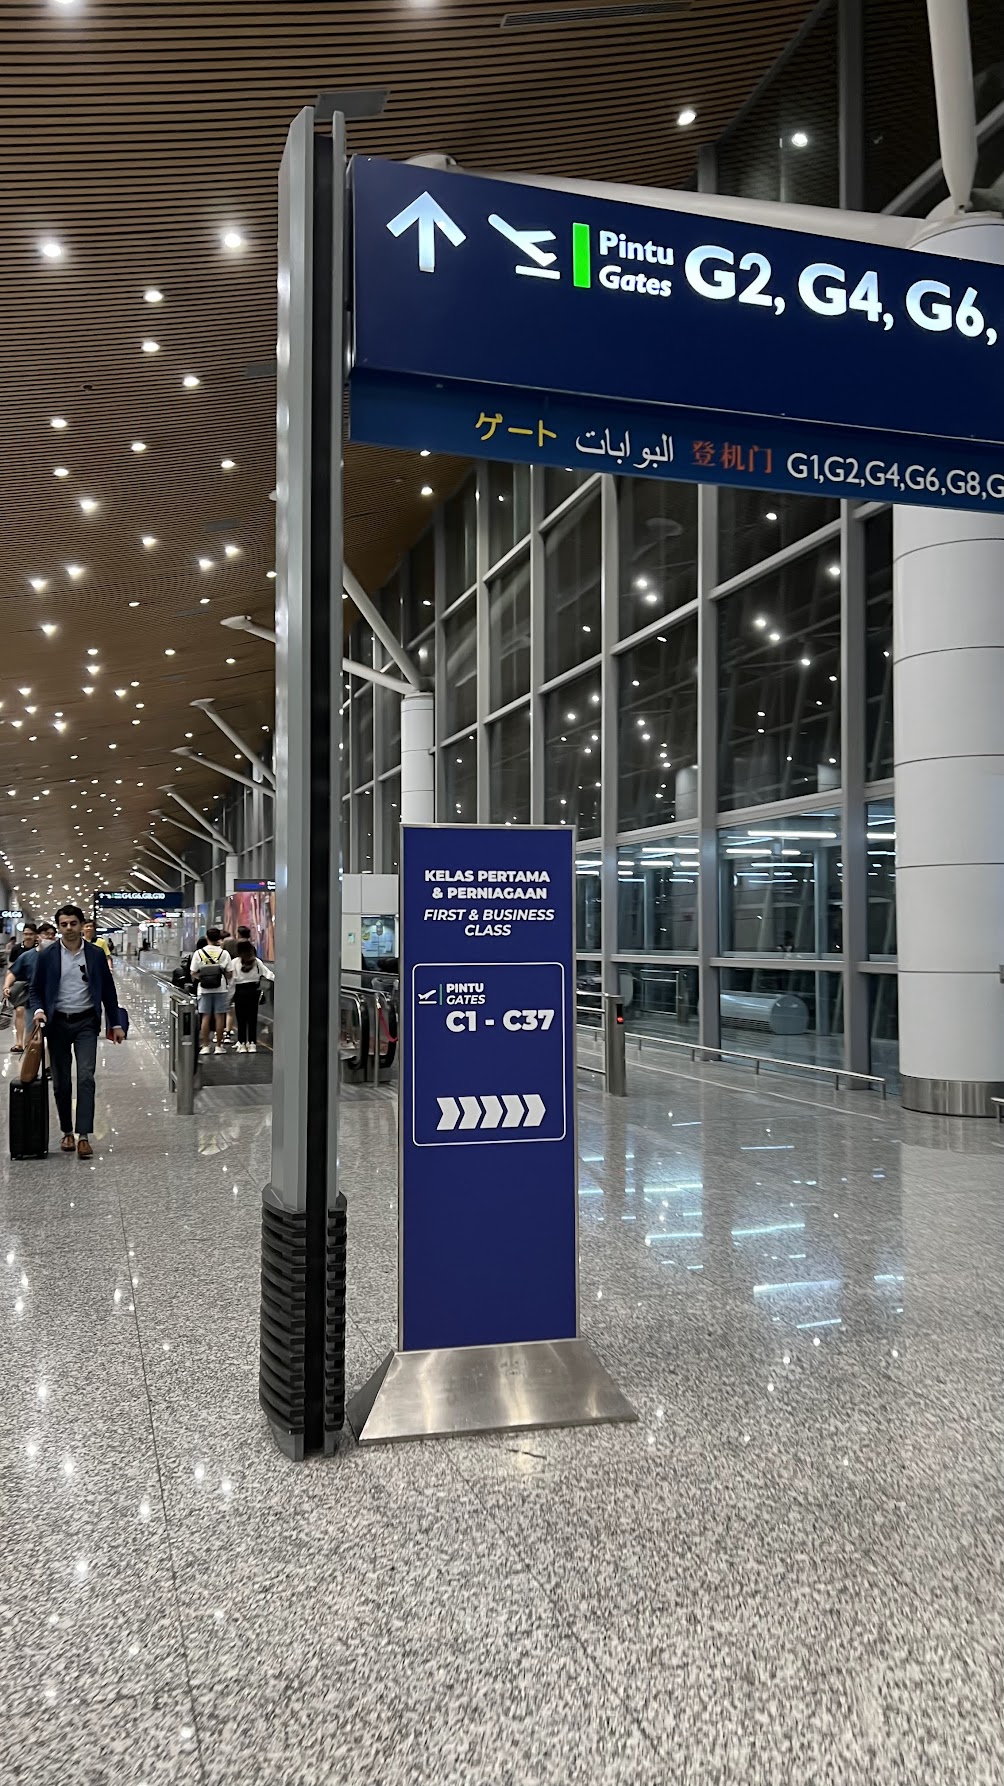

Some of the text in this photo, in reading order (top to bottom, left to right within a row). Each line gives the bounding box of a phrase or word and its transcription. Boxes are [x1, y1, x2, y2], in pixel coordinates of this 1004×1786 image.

[599, 230, 675, 266] Pintu
[598, 264, 672, 297] Gates
[684, 244, 998, 346] G2, G4, G6,
[475, 412, 557, 447] ゲート
[691, 440, 773, 474] 登机门
[424, 870, 551, 882] KELAS PERTAMA
[432, 887, 547, 899] & PERNIAGAAN
[423, 909, 555, 921] FIRST & BUSINESS
[464, 924, 512, 936] CLASS
[446, 983, 484, 993] PINTU
[446, 994, 486, 1005] GATES
[446, 1010, 477, 1032] C1
[502, 1009, 555, 1031] C37
